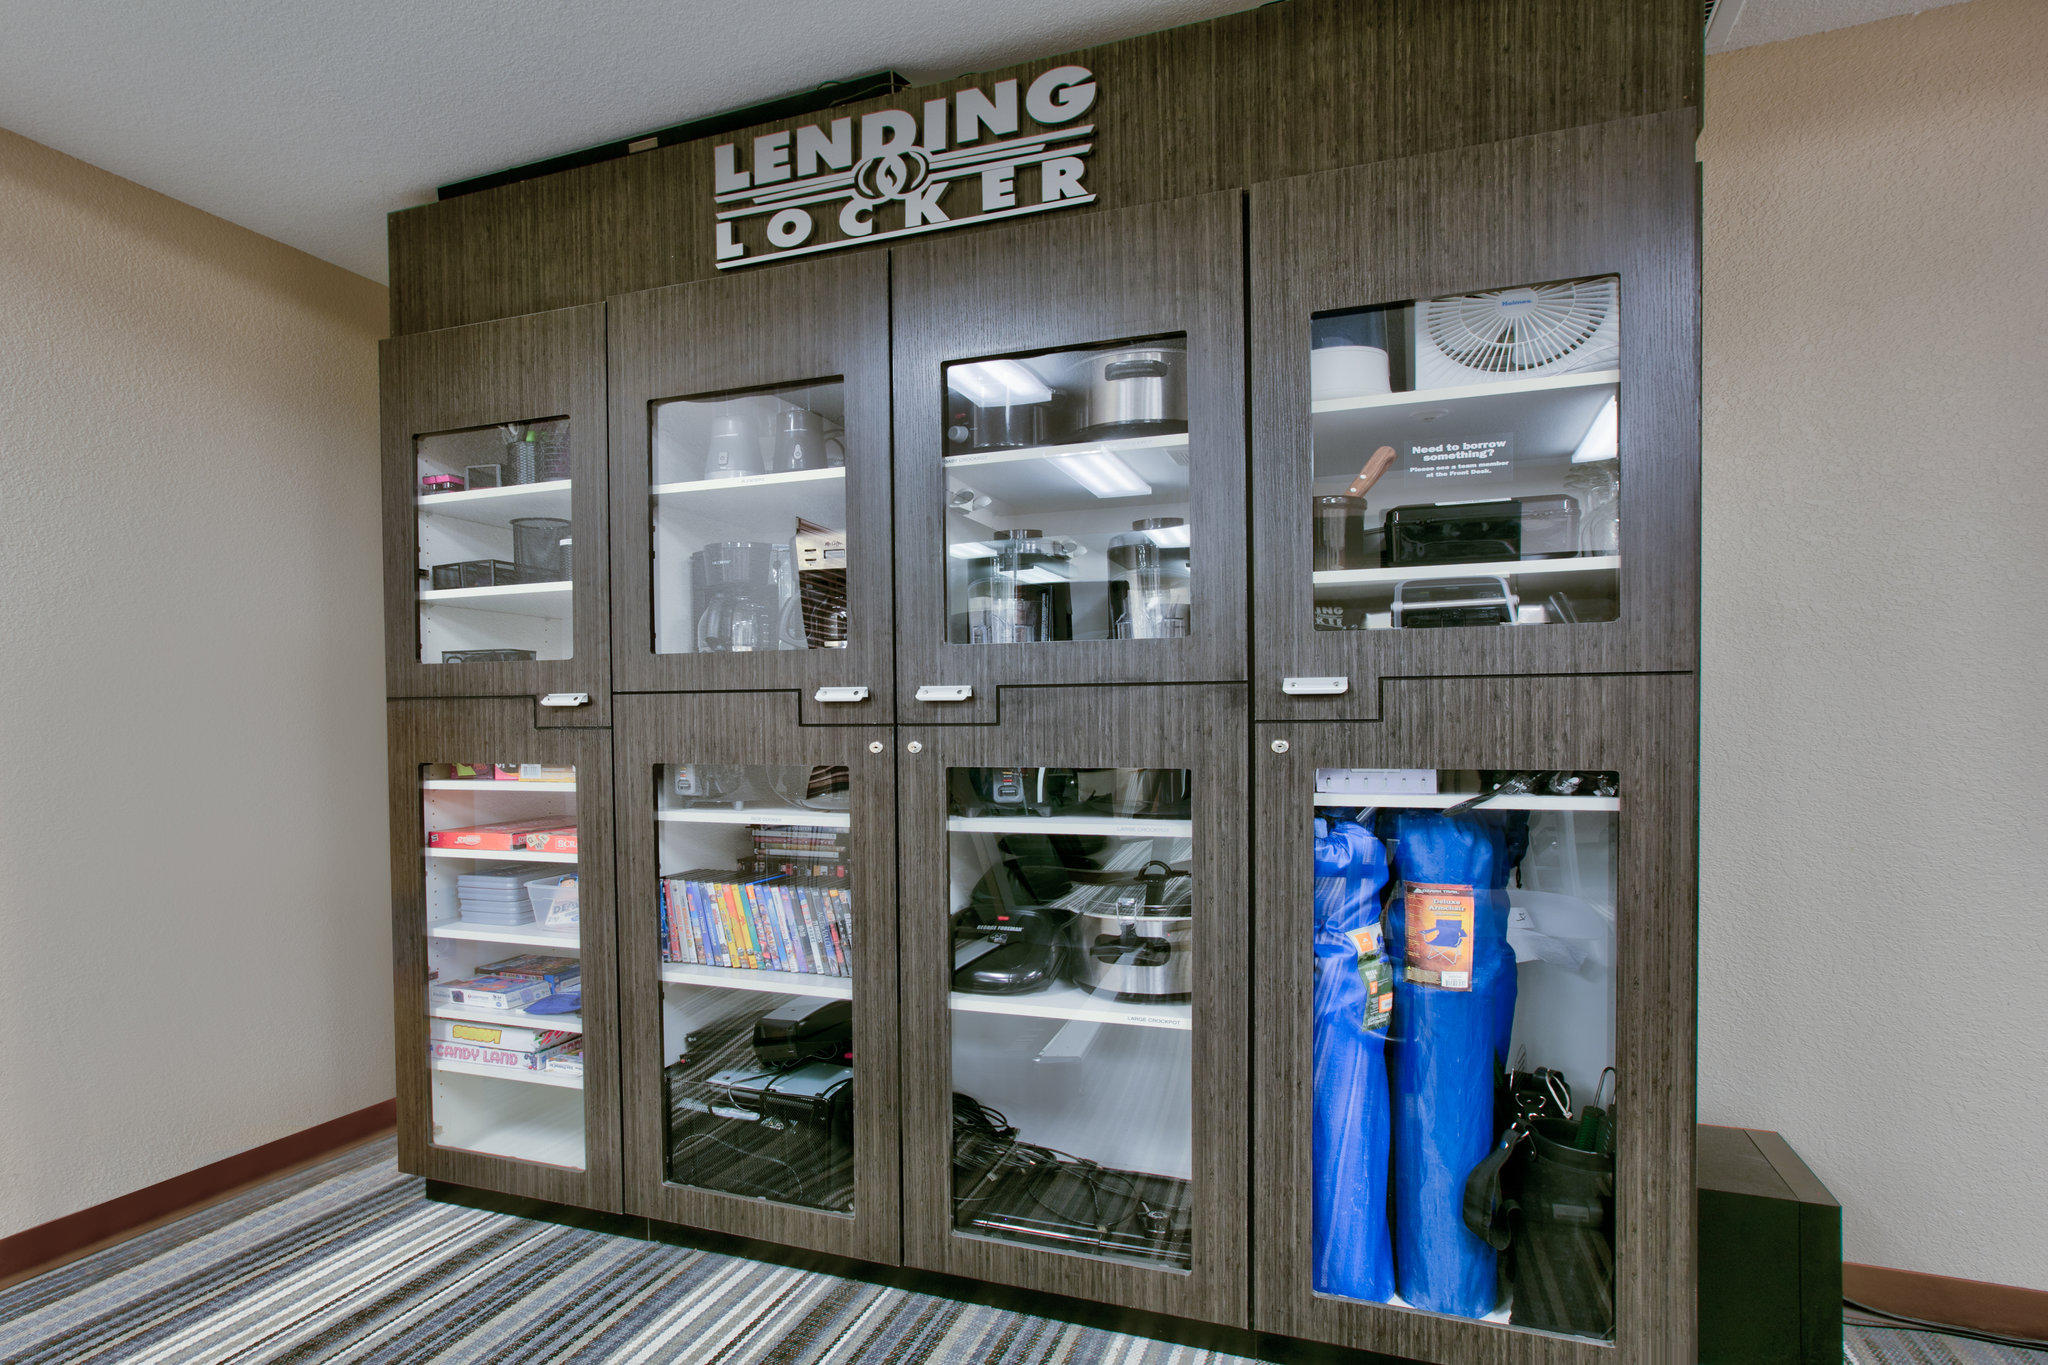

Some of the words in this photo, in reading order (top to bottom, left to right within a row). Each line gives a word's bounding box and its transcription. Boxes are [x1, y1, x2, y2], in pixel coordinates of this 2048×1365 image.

[714, 65, 1097, 194] LENDING
[716, 156, 1089, 260] LOCKER
[1412, 445, 1443, 454] Need
[1446, 443, 1460, 452] to
[1463, 440, 1506, 450] borrow
[1423, 449, 1495, 461] something?
[1148, 1017, 1180, 1025] CROCKPOT
[436, 1044, 479, 1062] CANDY
[482, 1050, 518, 1066] LAND
